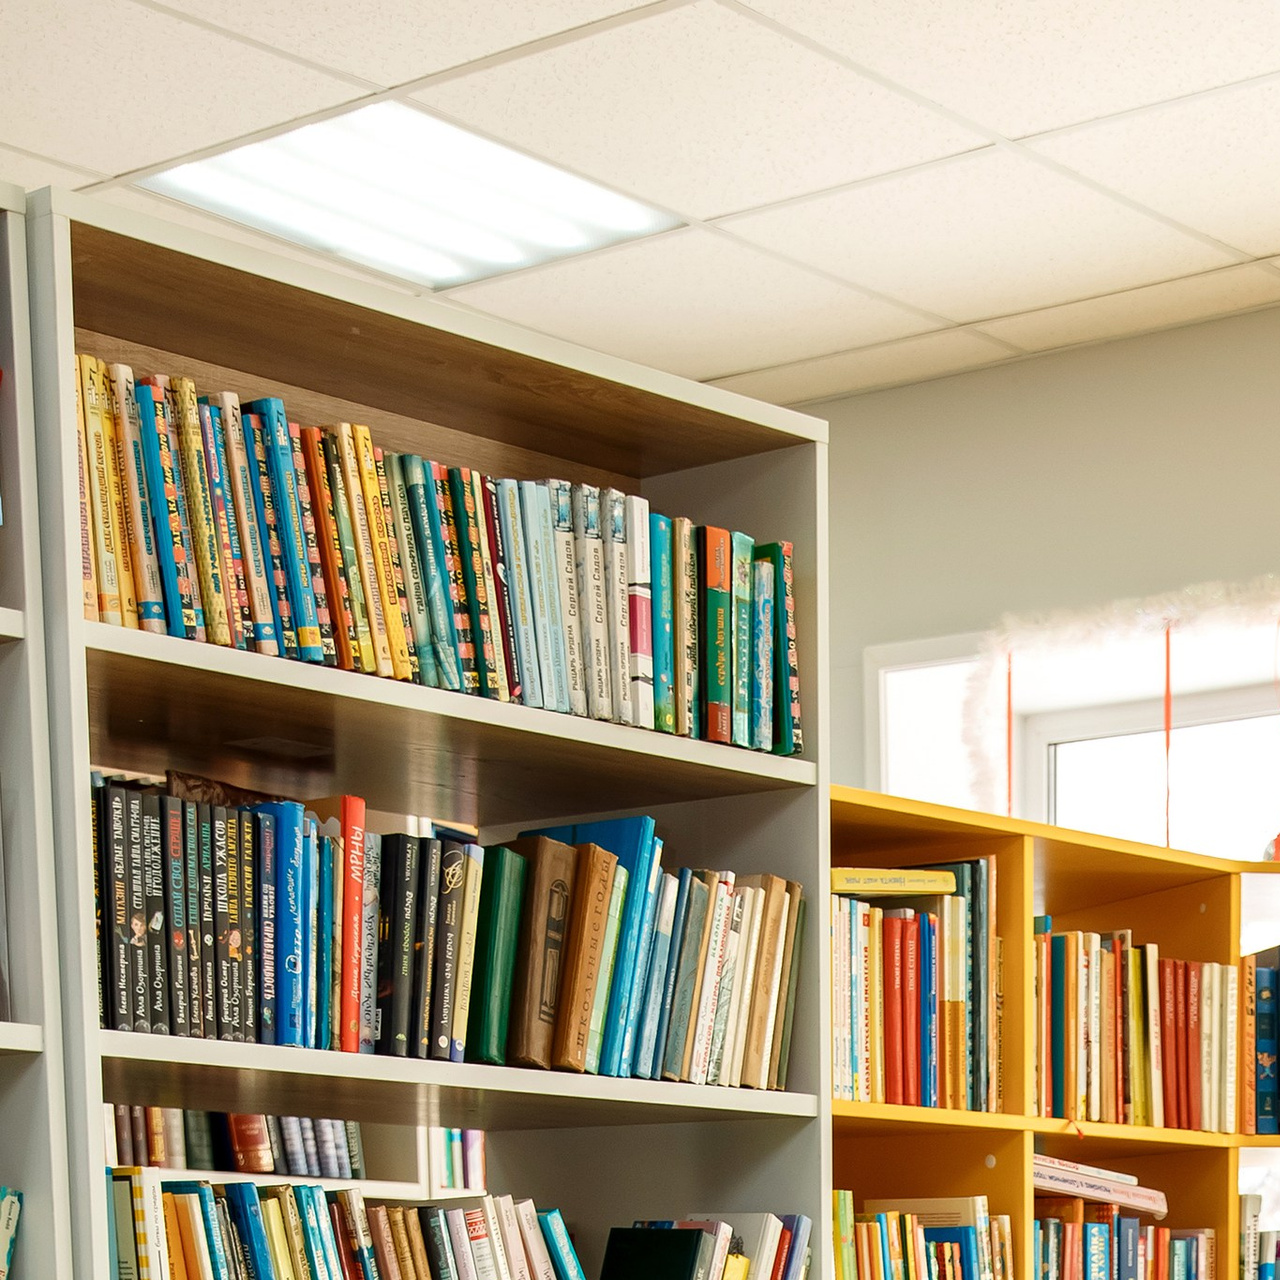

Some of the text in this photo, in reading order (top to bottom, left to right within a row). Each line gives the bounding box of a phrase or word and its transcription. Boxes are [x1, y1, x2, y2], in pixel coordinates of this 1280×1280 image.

[166, 495, 181, 549] ЗАГАДКА
[219, 511, 243, 631] МАГИЧЕСКИЙ ЖЕЗЛ
[372, 495, 397, 604] ВЕРХОВНЫЙ КОРОЛЬ
[564, 540, 577, 617] Сергей Садов
[592, 548, 603, 623] Сергей Садов
[619, 588, 628, 627] Сергей
[567, 624, 575, 655] ОРДЕНА
[151, 816, 162, 896] ПРОДОЛЖЕНИЕ
[202, 823, 212, 870] АРИАДНЫ
[227, 819, 236, 855] АМУЛЕТА
[216, 820, 228, 912] ШКОЛА УЖАСОВ
[244, 822, 252, 908] ГАДСКИЙ ГАДЖЕТ
[116, 881, 126, 924] МАГАЗИН
[173, 891, 184, 927] ОТДАЙ
[136, 950, 145, 992] Озорнина
[153, 945, 164, 988] Озорнина
[264, 921, 275, 999] СПРАВЕДЛИВОСТЬ
[577, 860, 610, 1047] ШКОЛЬНЫЕ ГОДЫ
[175, 991, 185, 1023] Валерий
[191, 1000, 200, 1023] Елена
[205, 1002, 213, 1021] Анна
[221, 961, 231, 1023] Григорий Остер
[246, 1001, 254, 1027] Антон
[441, 983, 451, 1027] Ловушка
